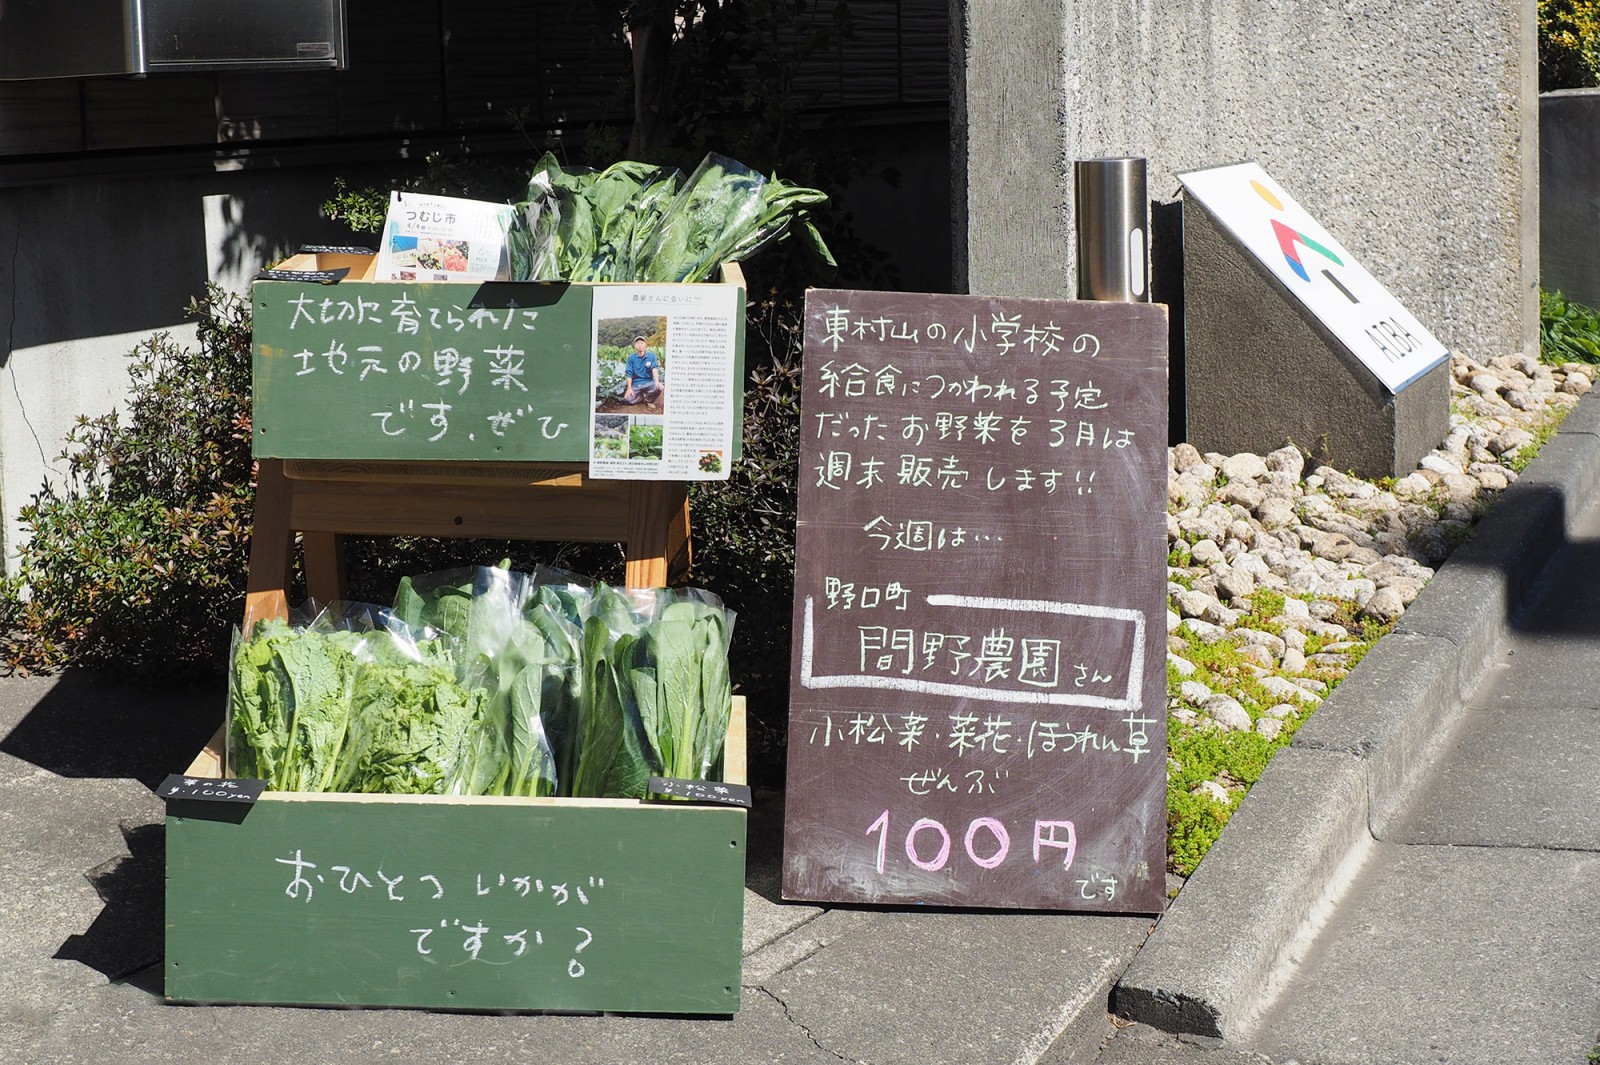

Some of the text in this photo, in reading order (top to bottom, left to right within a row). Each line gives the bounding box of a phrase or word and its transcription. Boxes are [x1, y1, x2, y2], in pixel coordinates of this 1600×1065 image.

[405, 210, 457, 225] つむじ市
[822, 309, 1100, 357] 東村山の小学校の
[1364, 316, 1423, 363] AIBA
[293, 338, 528, 395] 地元の野菜
[818, 360, 1107, 411] 給食につかわれる予定
[825, 577, 912, 610] 野口町
[900, 767, 1009, 795] ぜんぶ
[865, 809, 1077, 875] 100円
[1075, 874, 1118, 901] です
